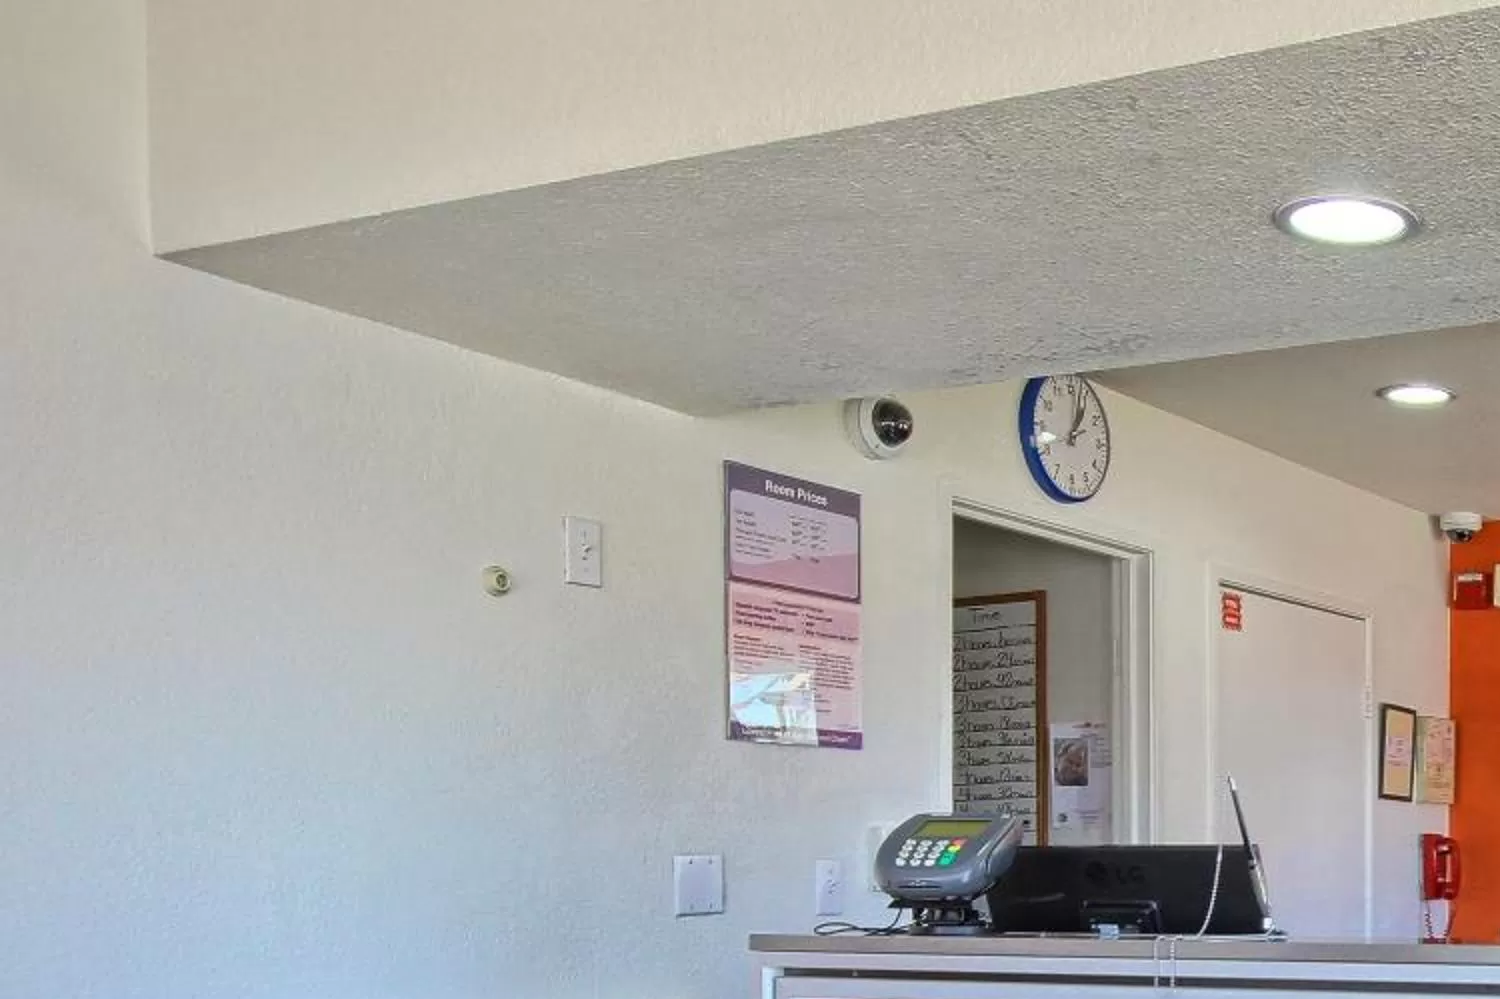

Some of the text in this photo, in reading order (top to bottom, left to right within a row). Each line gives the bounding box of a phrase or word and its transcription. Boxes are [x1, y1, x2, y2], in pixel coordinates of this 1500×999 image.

[765, 479, 828, 507] Room Prices
[1115, 866, 1145, 885] LG
